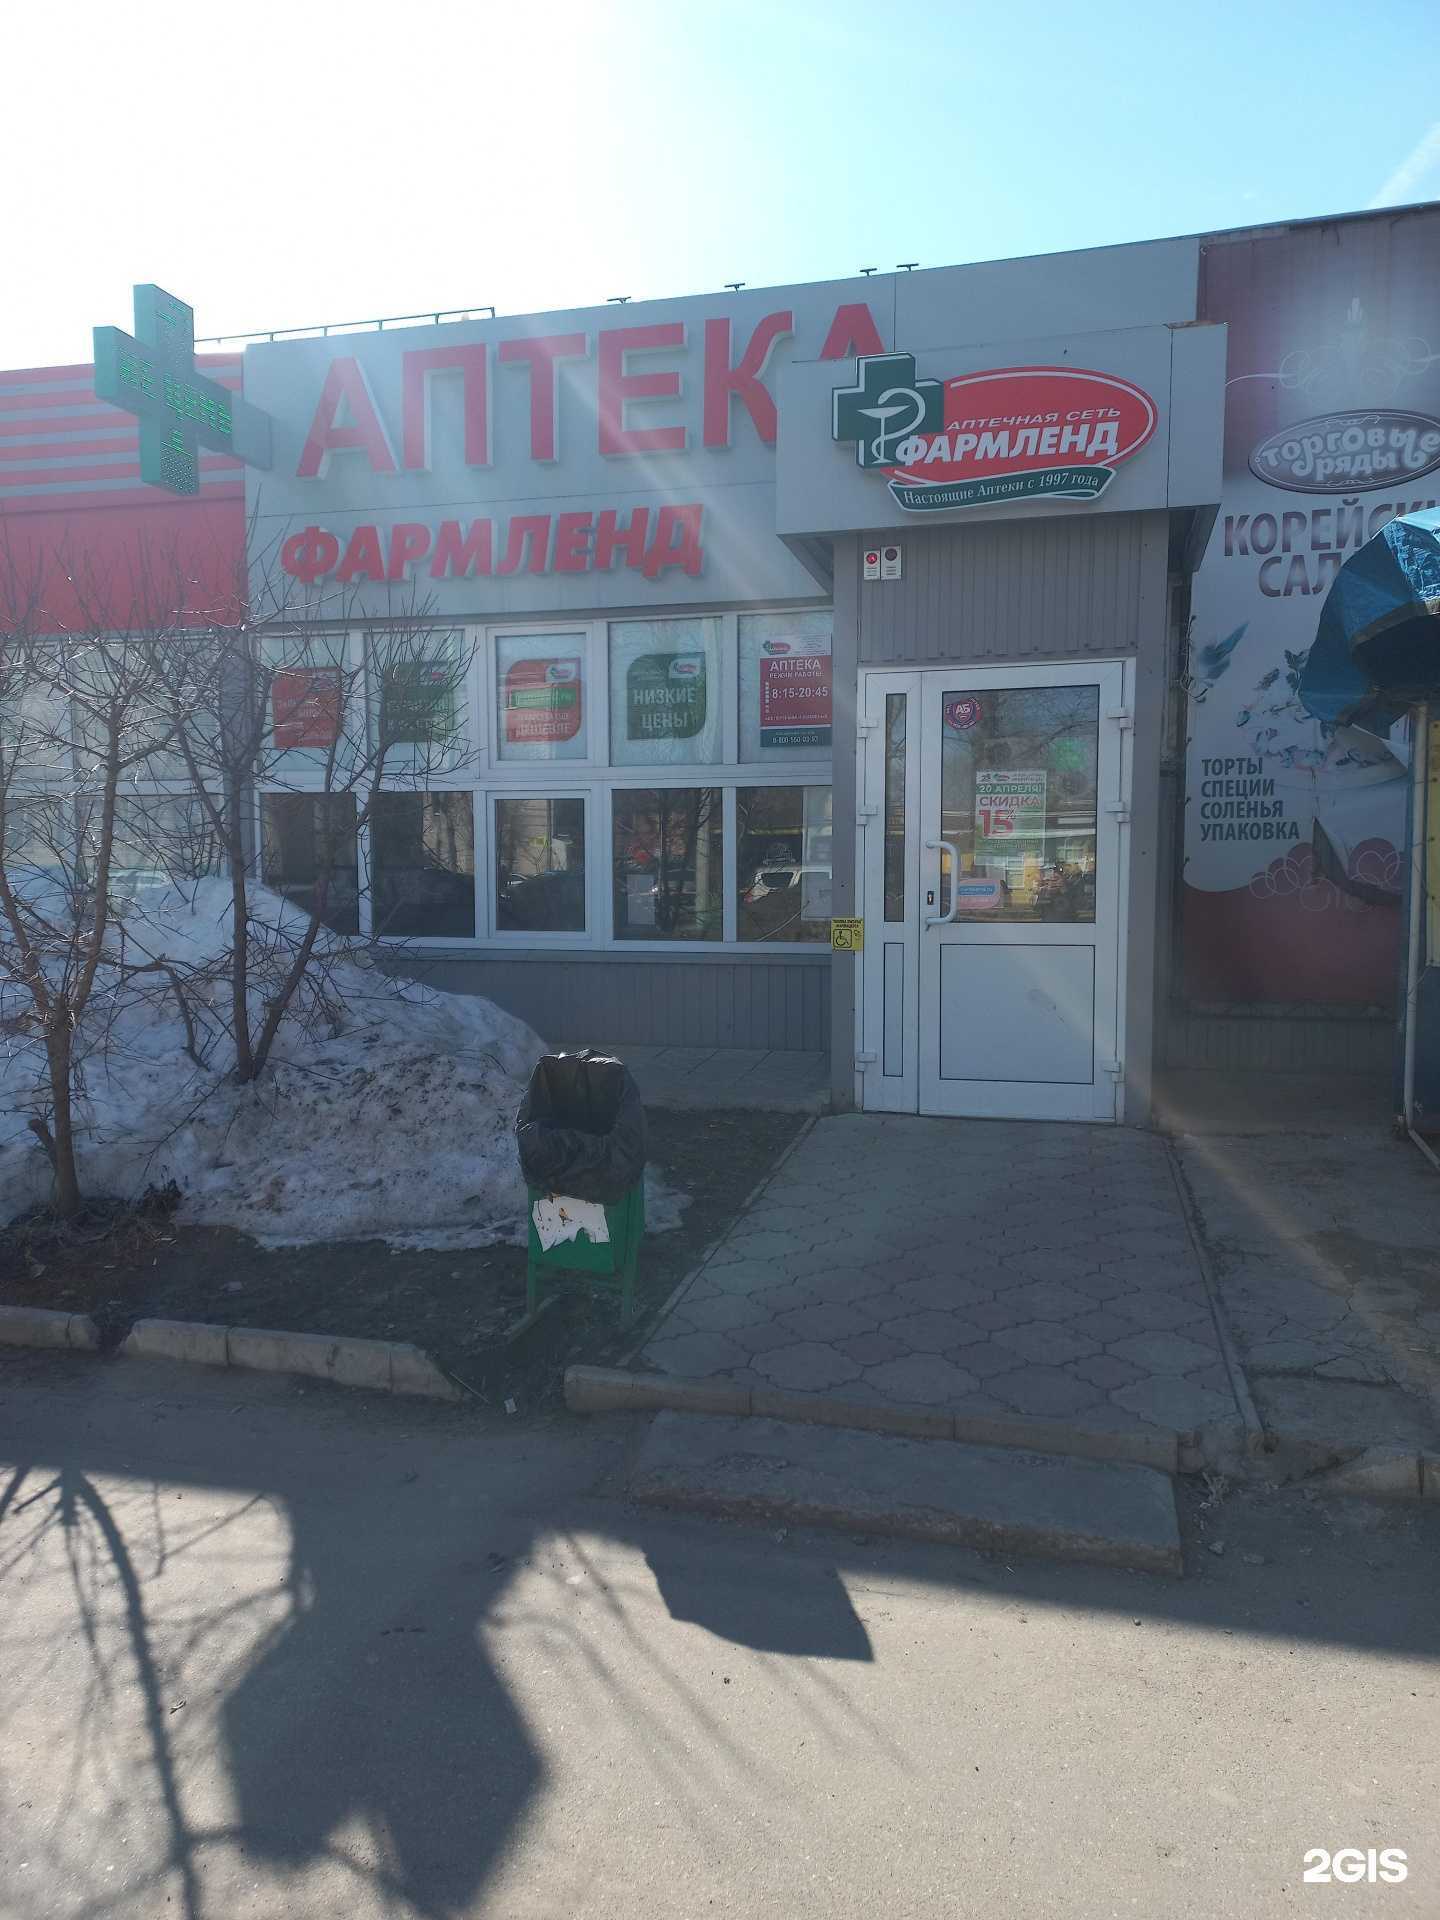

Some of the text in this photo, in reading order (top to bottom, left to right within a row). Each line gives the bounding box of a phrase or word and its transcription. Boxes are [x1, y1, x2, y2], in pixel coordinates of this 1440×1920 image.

[946, 407, 1121, 431] АПТЕЧНАЯ СЕТЬ
[895, 421, 1120, 466] ФАРМЛЕНД
[904, 488, 974, 505] Настоящие
[978, 480, 1024, 497] Аптеки
[1039, 473, 1068, 487] 1997
[1072, 474, 1099, 486] года
[1224, 498, 1440, 557] КОРЕЙС
[281, 503, 703, 584] ФАРМЛЕНД
[1258, 553, 1342, 597] САЛ
[770, 659, 822, 671] АПТЕКА
[633, 687, 697, 704] НИЗКИЕ
[772, 687, 828, 699] 8:15-20:45
[641, 712, 688, 731] ЦЕНЫ
[1201, 757, 1263, 776] ТОРТЫ
[980, 785, 992, 793] 20
[1201, 779, 1275, 800] СПЕЦИИ
[980, 795, 1041, 807] СКИДКА
[1200, 800, 1284, 819] СОЛЕНЬЯ
[1200, 821, 1300, 842] УПАКОВКА
